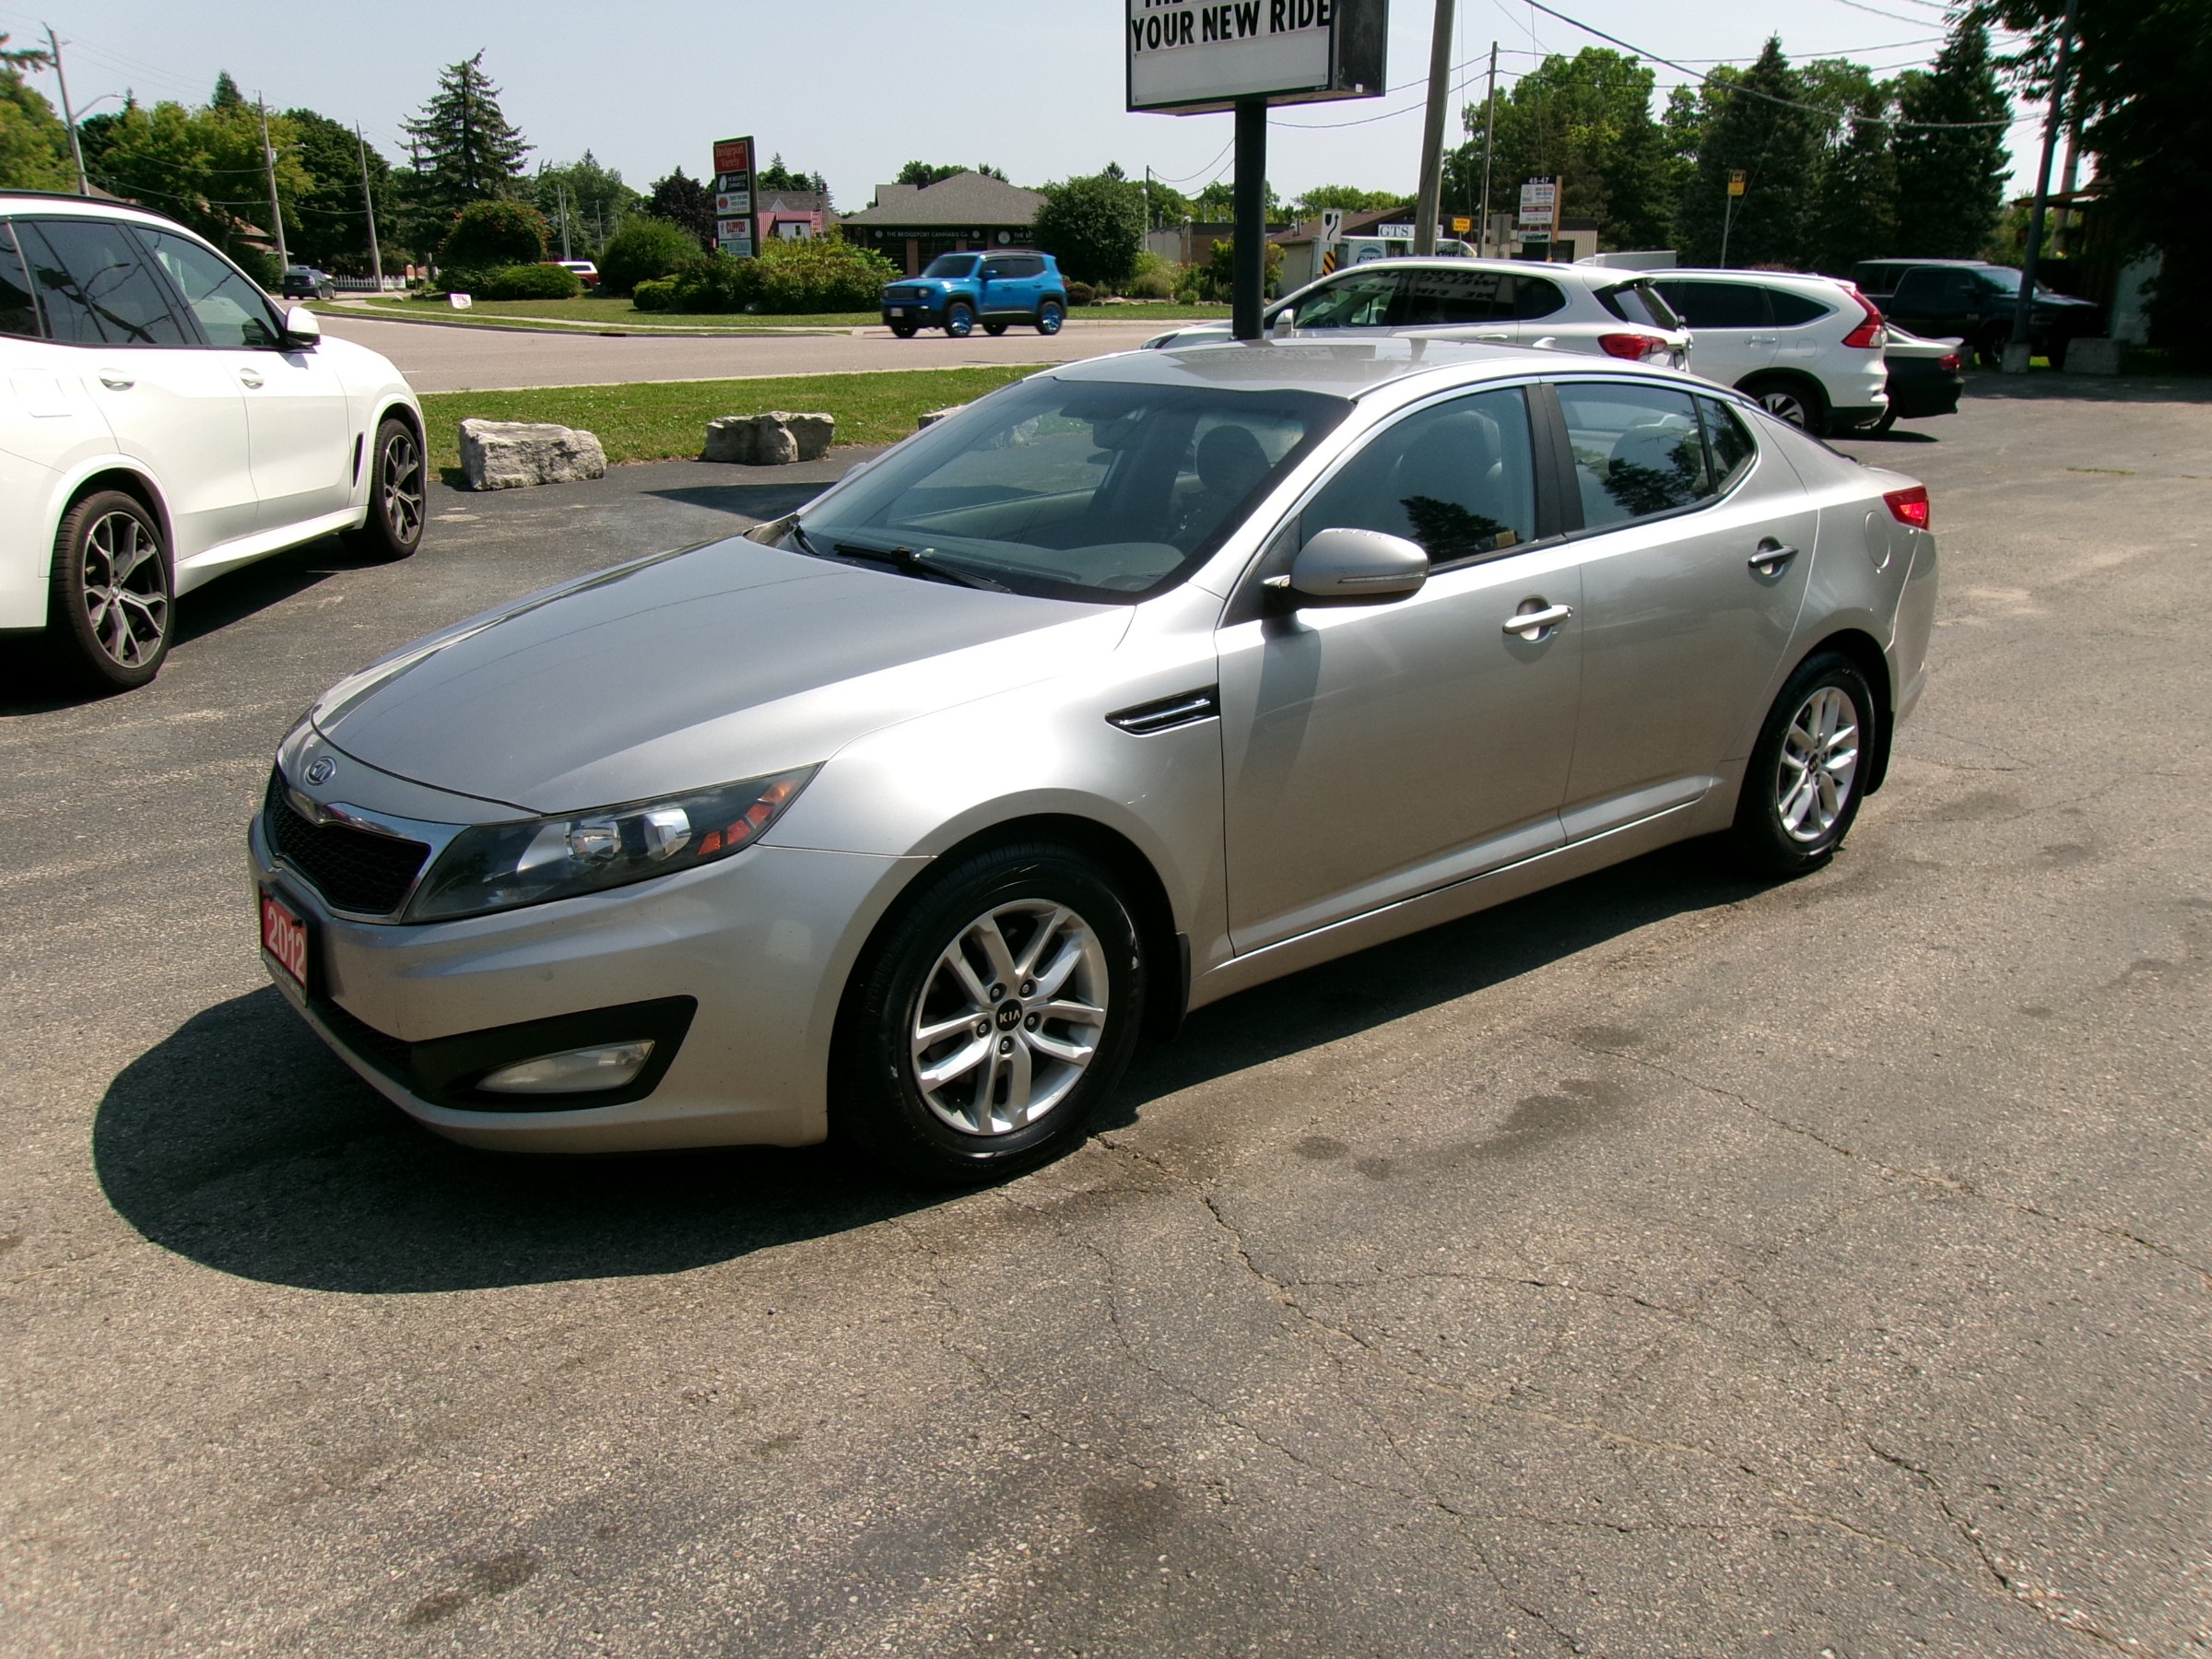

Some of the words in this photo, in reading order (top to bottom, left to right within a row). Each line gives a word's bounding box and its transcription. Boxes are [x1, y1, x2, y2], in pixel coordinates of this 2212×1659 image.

[1132, 10, 1194, 52] YOUR
[1203, 1, 1260, 42] NEW
[1270, 0, 1330, 33] RIDE
[1380, 226, 1409, 237] GTS
[268, 906, 305, 982] 2012
[999, 1009, 1020, 1023] KIA
